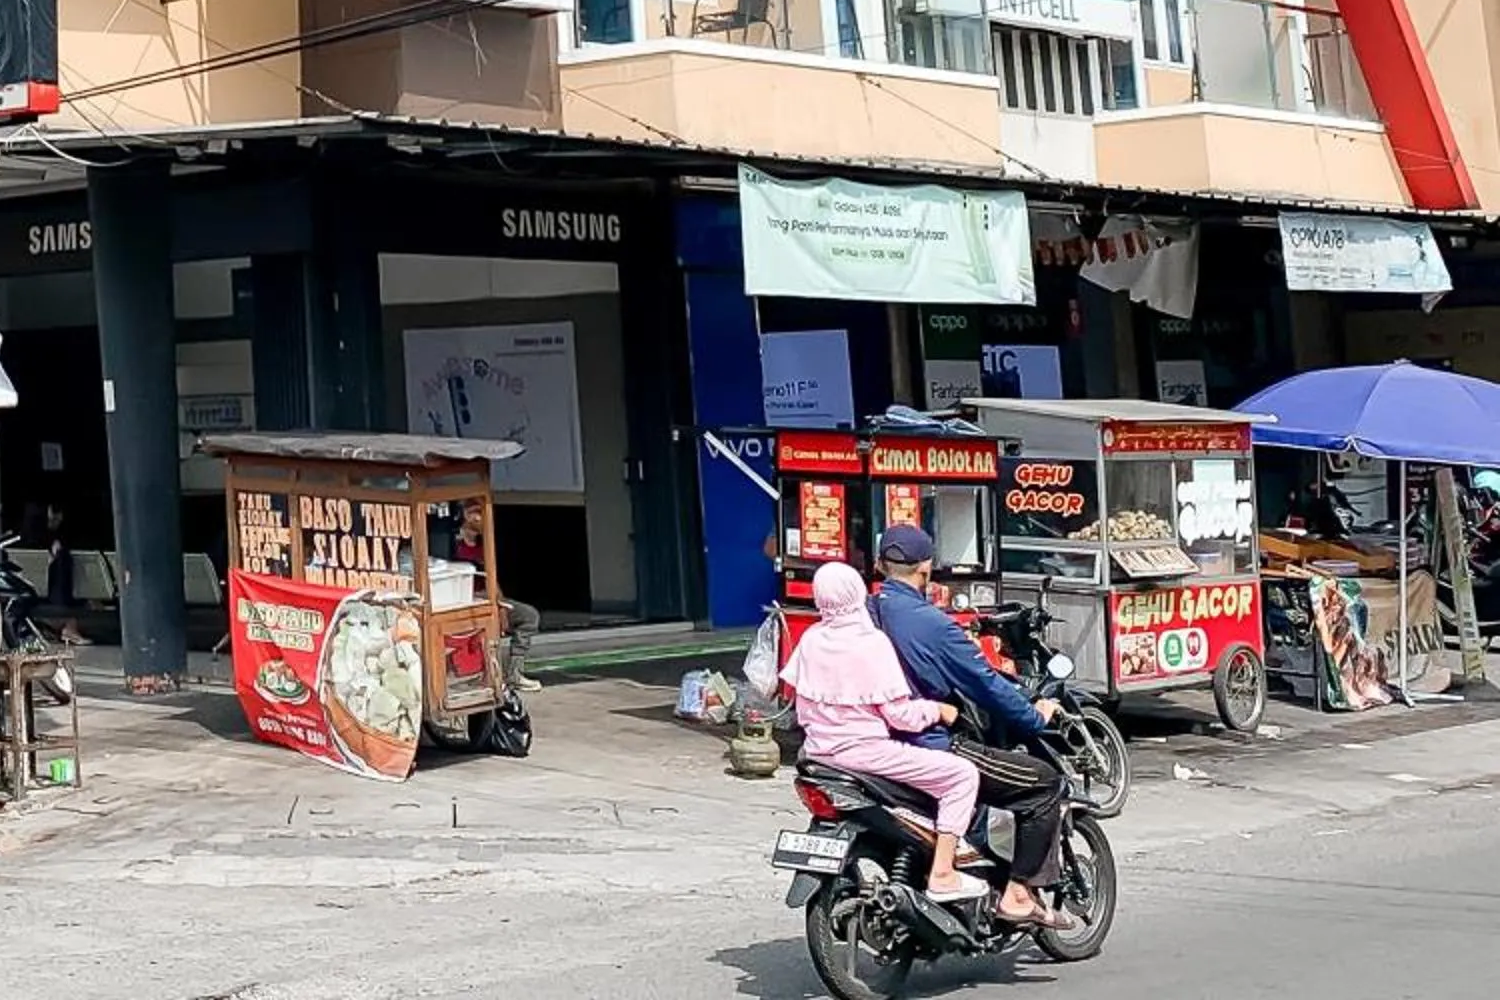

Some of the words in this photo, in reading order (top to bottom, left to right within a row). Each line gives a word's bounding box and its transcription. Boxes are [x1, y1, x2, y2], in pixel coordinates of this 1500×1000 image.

[29, 221, 92, 254] SAMS
[502, 208, 621, 242] SAMSUNG
[929, 313, 967, 333] oppo
[704, 437, 763, 459] vvo
[1015, 463, 1074, 489] GEHU
[299, 495, 353, 533] BASO
[361, 503, 413, 540] TAHU
[1006, 489, 1085, 518] GACOR
[1118, 590, 1175, 634] GEHU
[1179, 585, 1253, 627] GACOR
